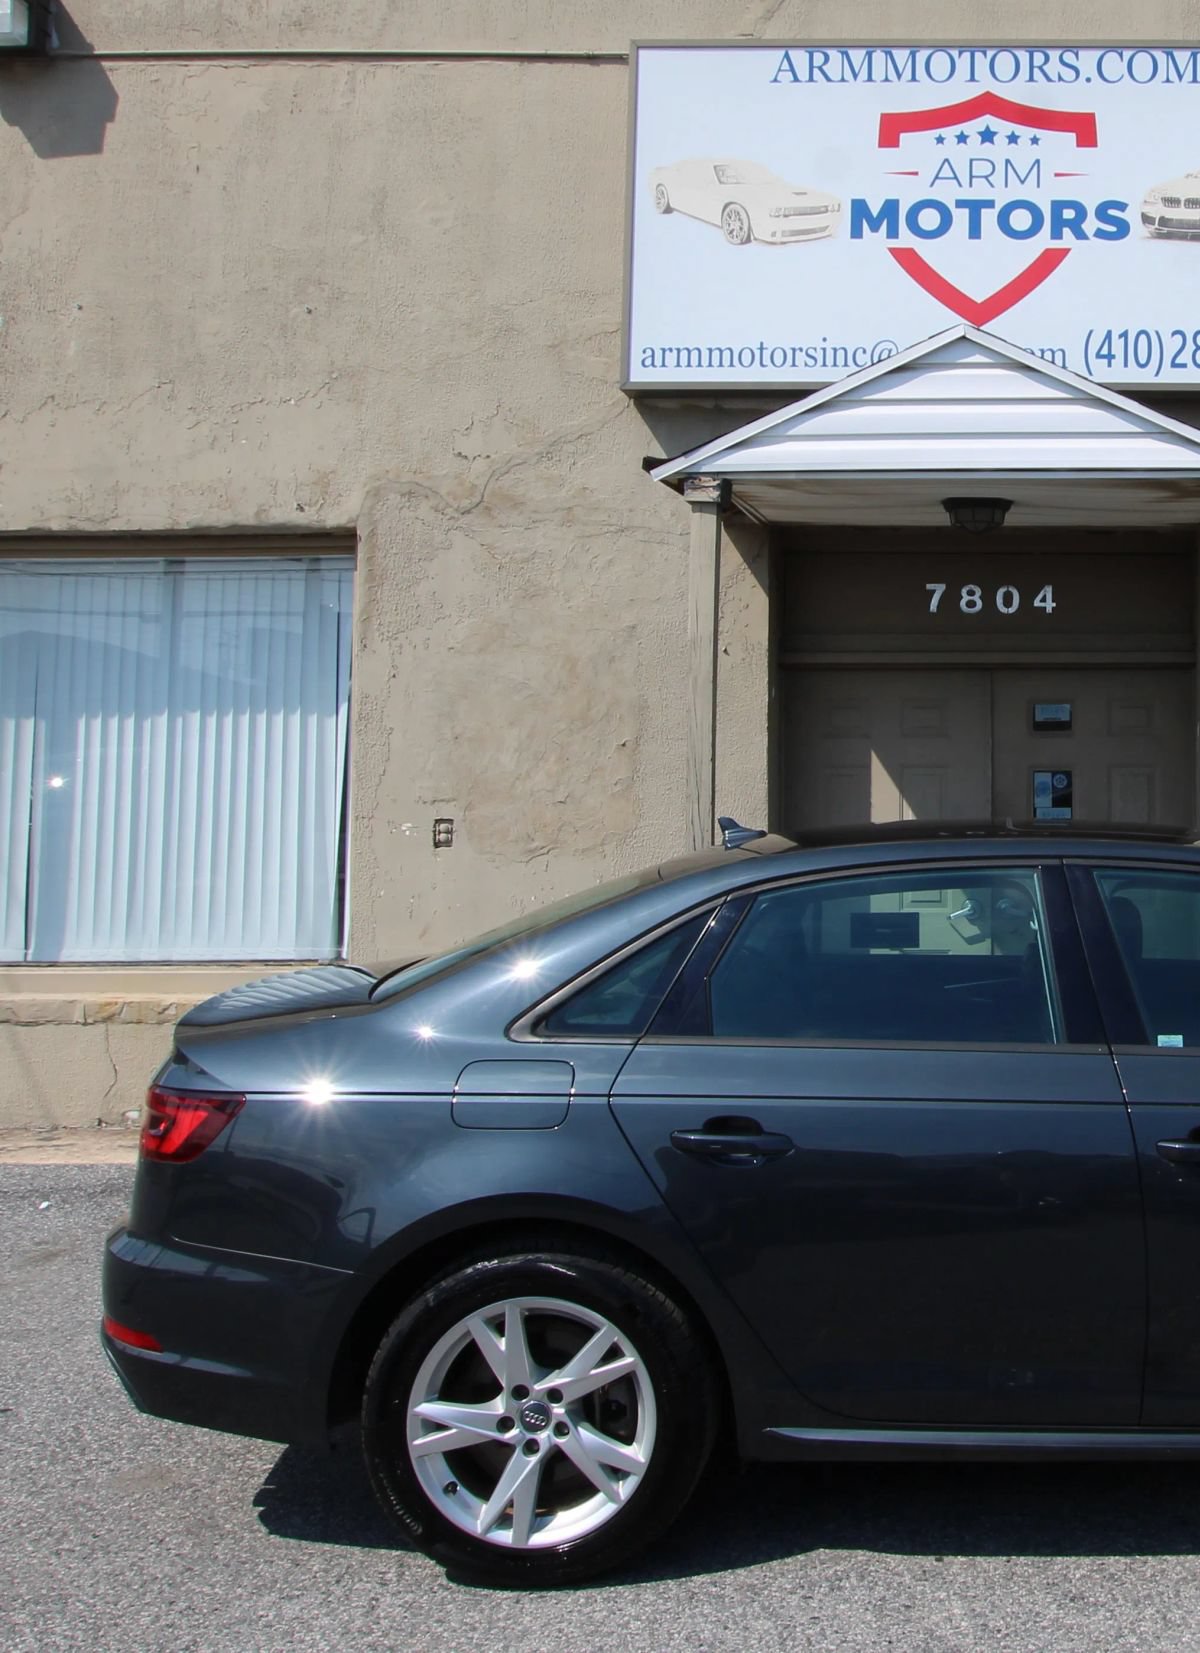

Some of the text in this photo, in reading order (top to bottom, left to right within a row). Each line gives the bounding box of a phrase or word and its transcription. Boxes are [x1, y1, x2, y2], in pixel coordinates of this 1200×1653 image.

[929, 158, 1041, 189] ARM
[849, 199, 1131, 241] MOTORS
[925, 583, 1057, 615] 7804
